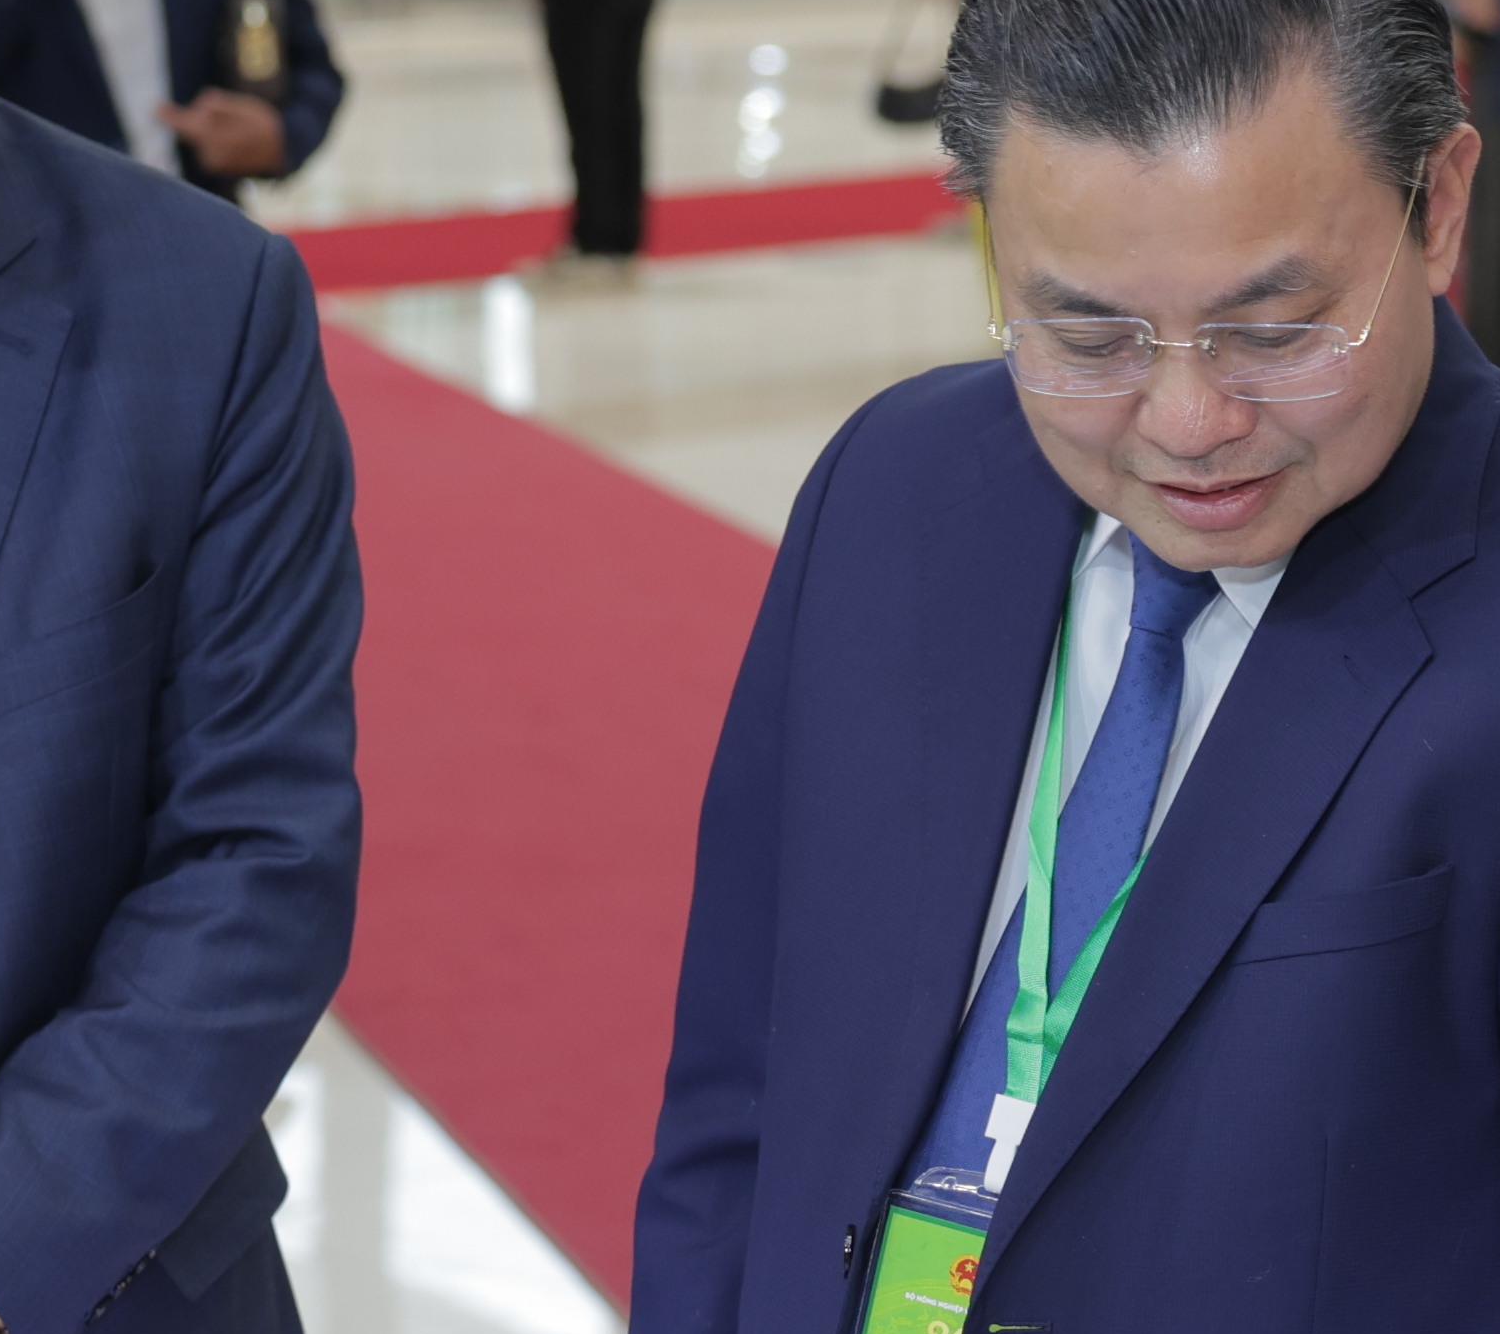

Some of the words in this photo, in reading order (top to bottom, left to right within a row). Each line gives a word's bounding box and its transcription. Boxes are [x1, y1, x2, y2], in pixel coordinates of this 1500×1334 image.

[905, 1291, 916, 1301] BỘ
[916, 1295, 937, 1306] NÔNG
[938, 1301, 963, 1314] NGHIỆP
